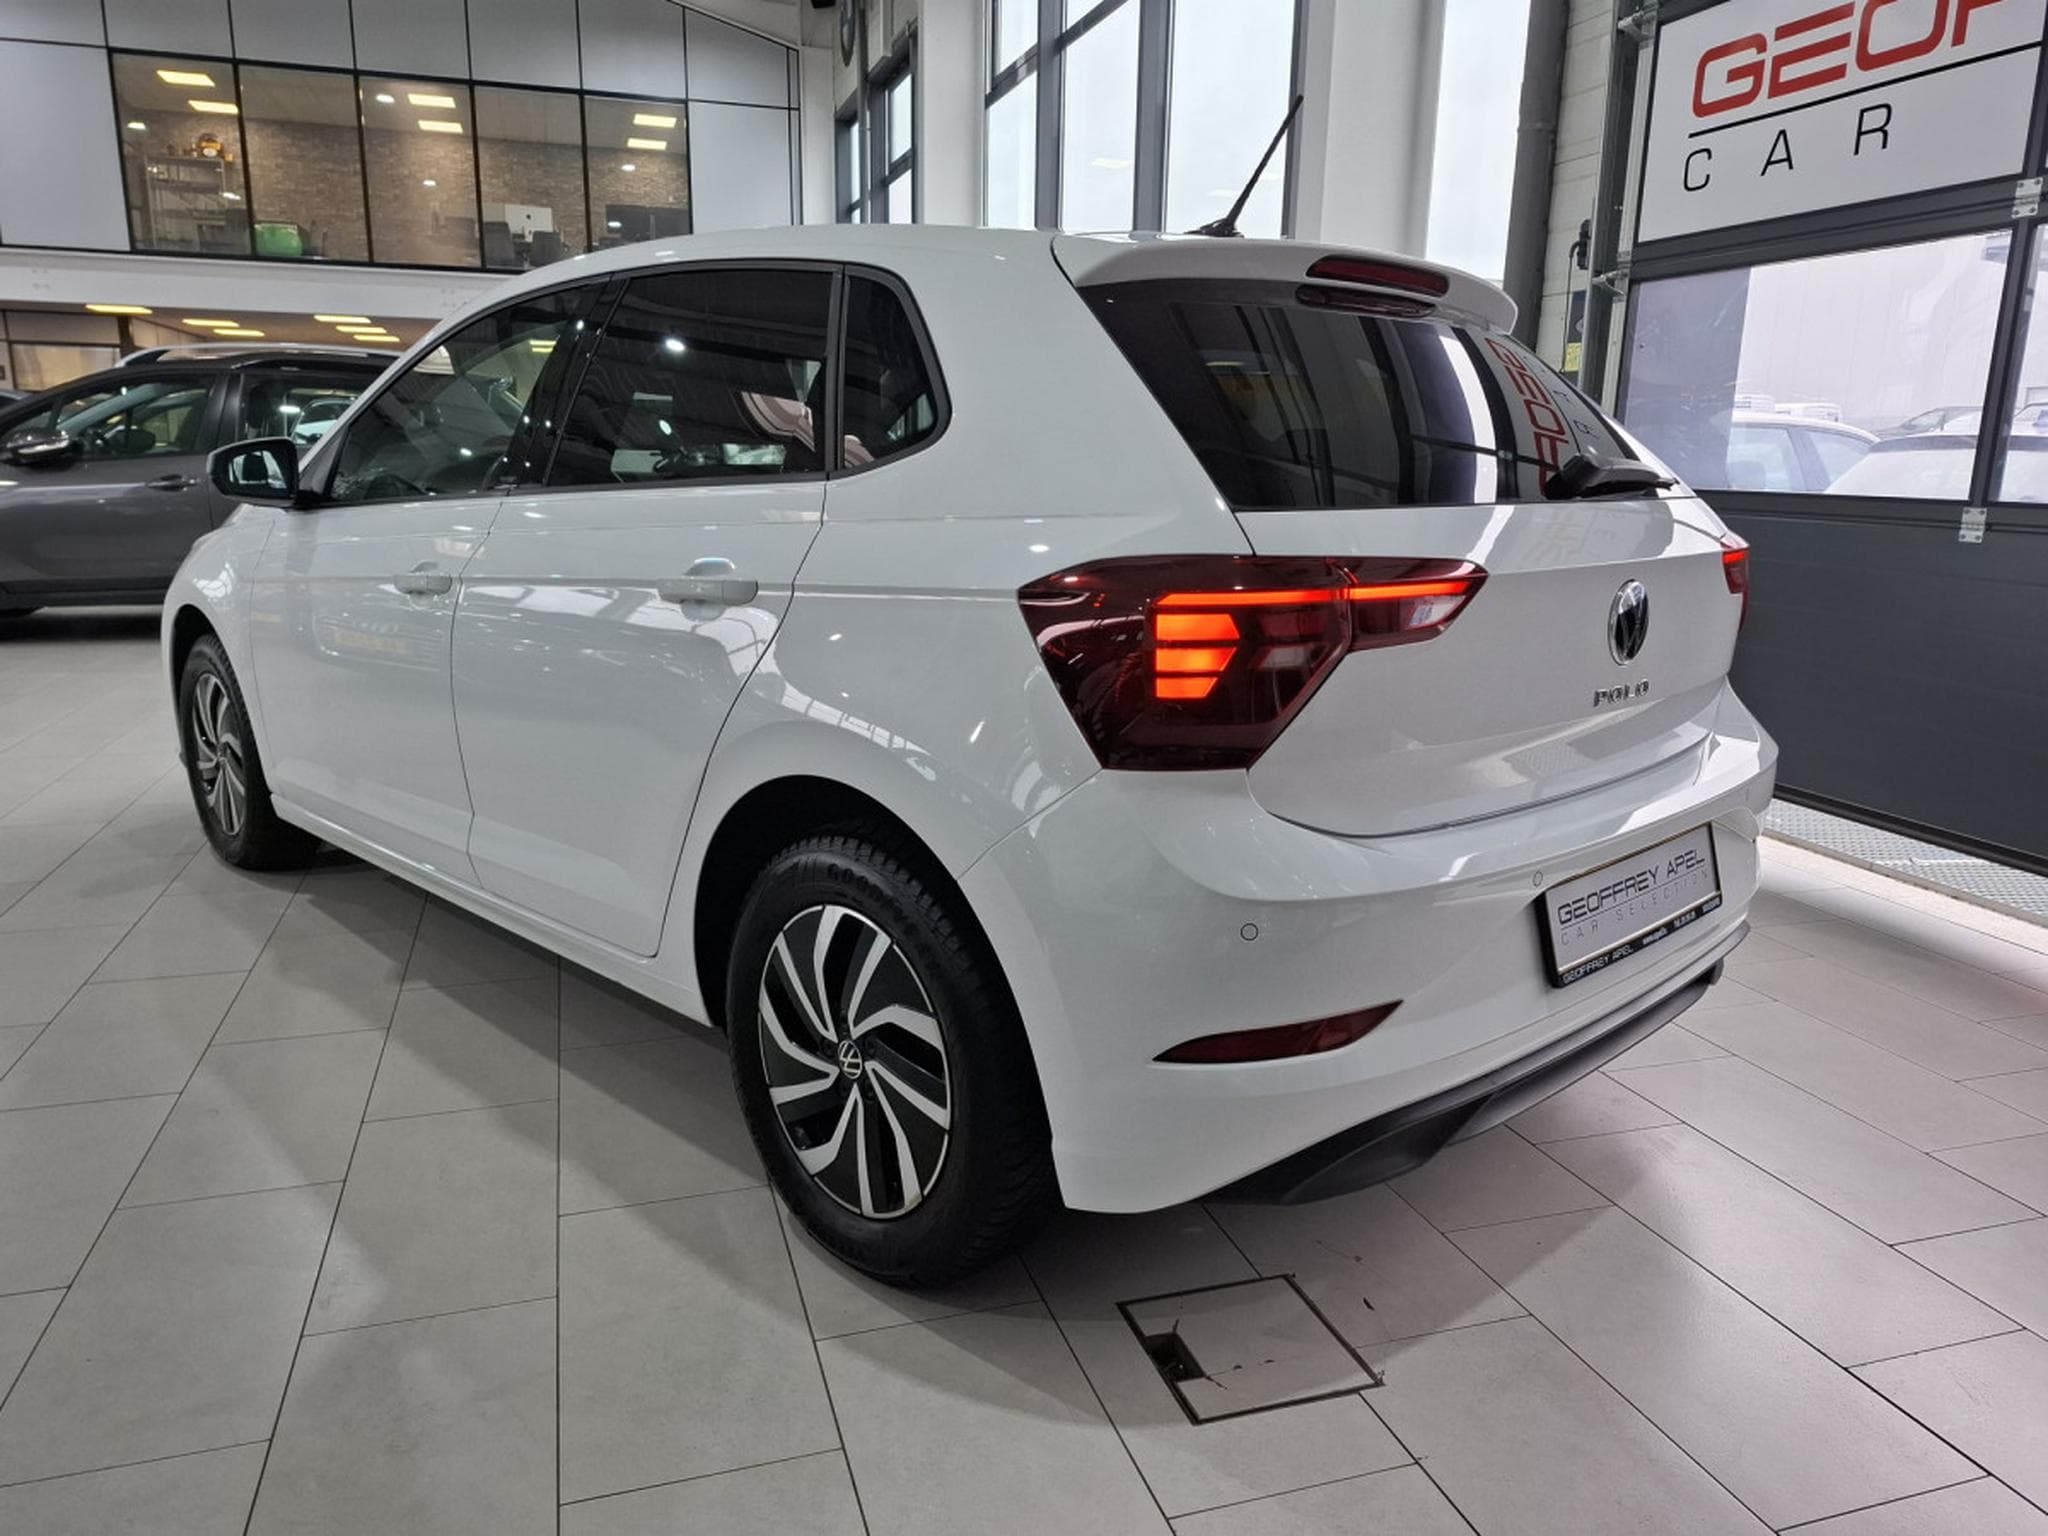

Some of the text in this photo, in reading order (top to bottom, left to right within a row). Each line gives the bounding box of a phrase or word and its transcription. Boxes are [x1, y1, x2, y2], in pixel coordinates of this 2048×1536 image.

[1682, 103, 1892, 192] CAR
[1593, 679, 1649, 707] POLO
[1557, 866, 1660, 925] GEOFFREY
[1666, 849, 1706, 878] APEL
